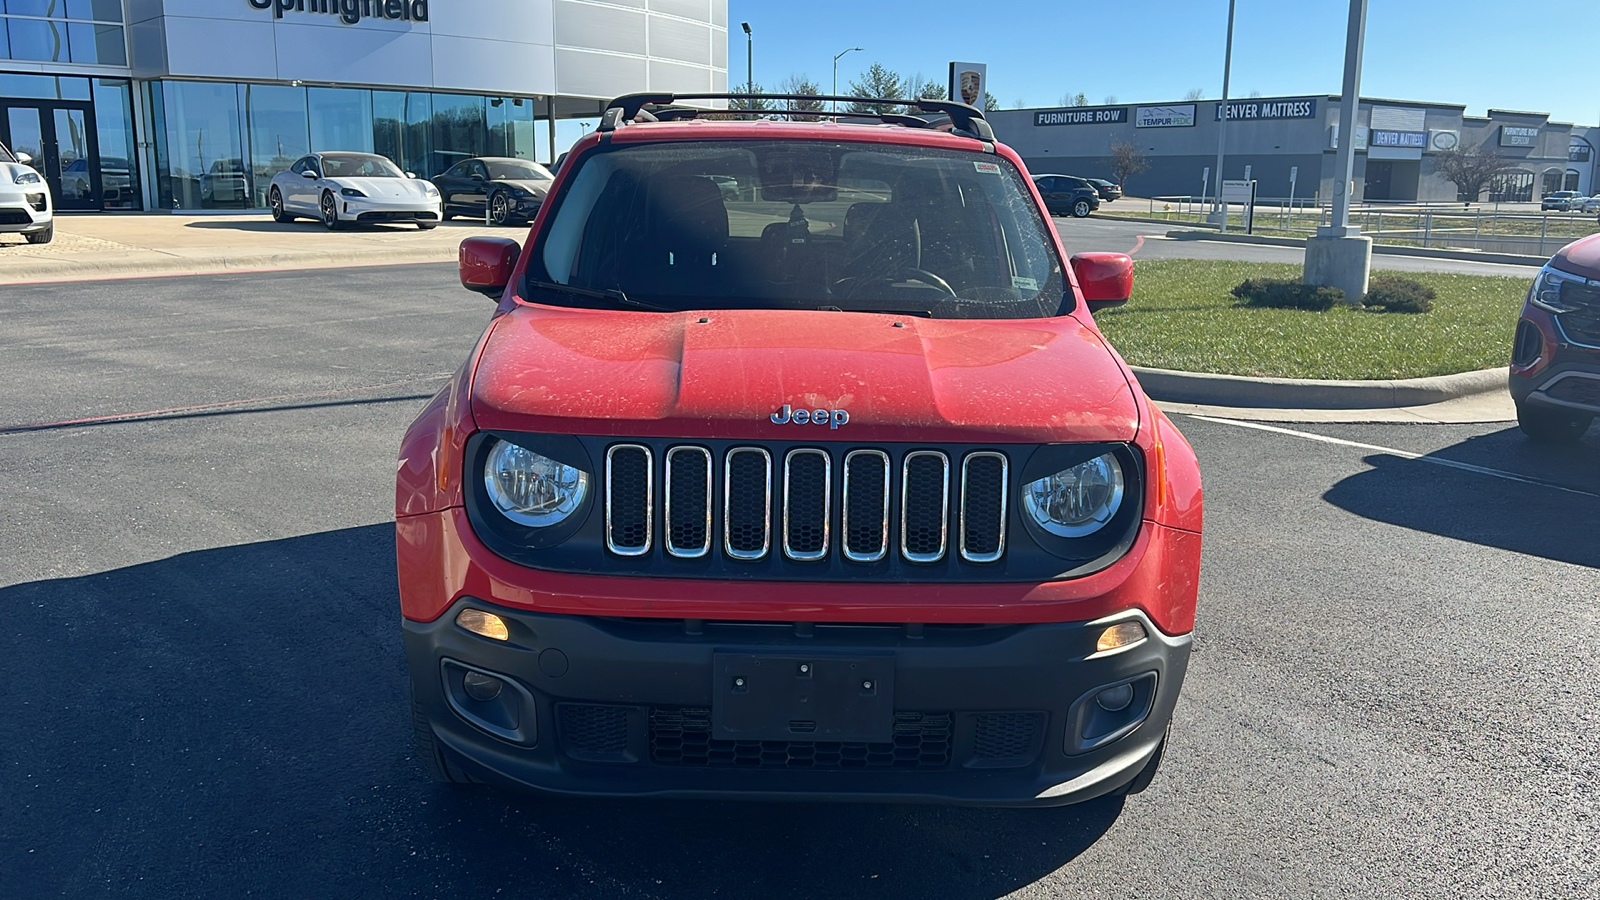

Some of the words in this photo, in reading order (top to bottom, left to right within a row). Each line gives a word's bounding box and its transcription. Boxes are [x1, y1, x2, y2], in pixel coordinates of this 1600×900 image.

[1261, 102, 1310, 117] MATTRESS
[1038, 112, 1093, 124] FURNITURE
[1096, 110, 1120, 122] ROW
[1377, 132, 1398, 145] DENVER
[1399, 133, 1424, 146] MATTRESS
[770, 404, 850, 430] Jeep
